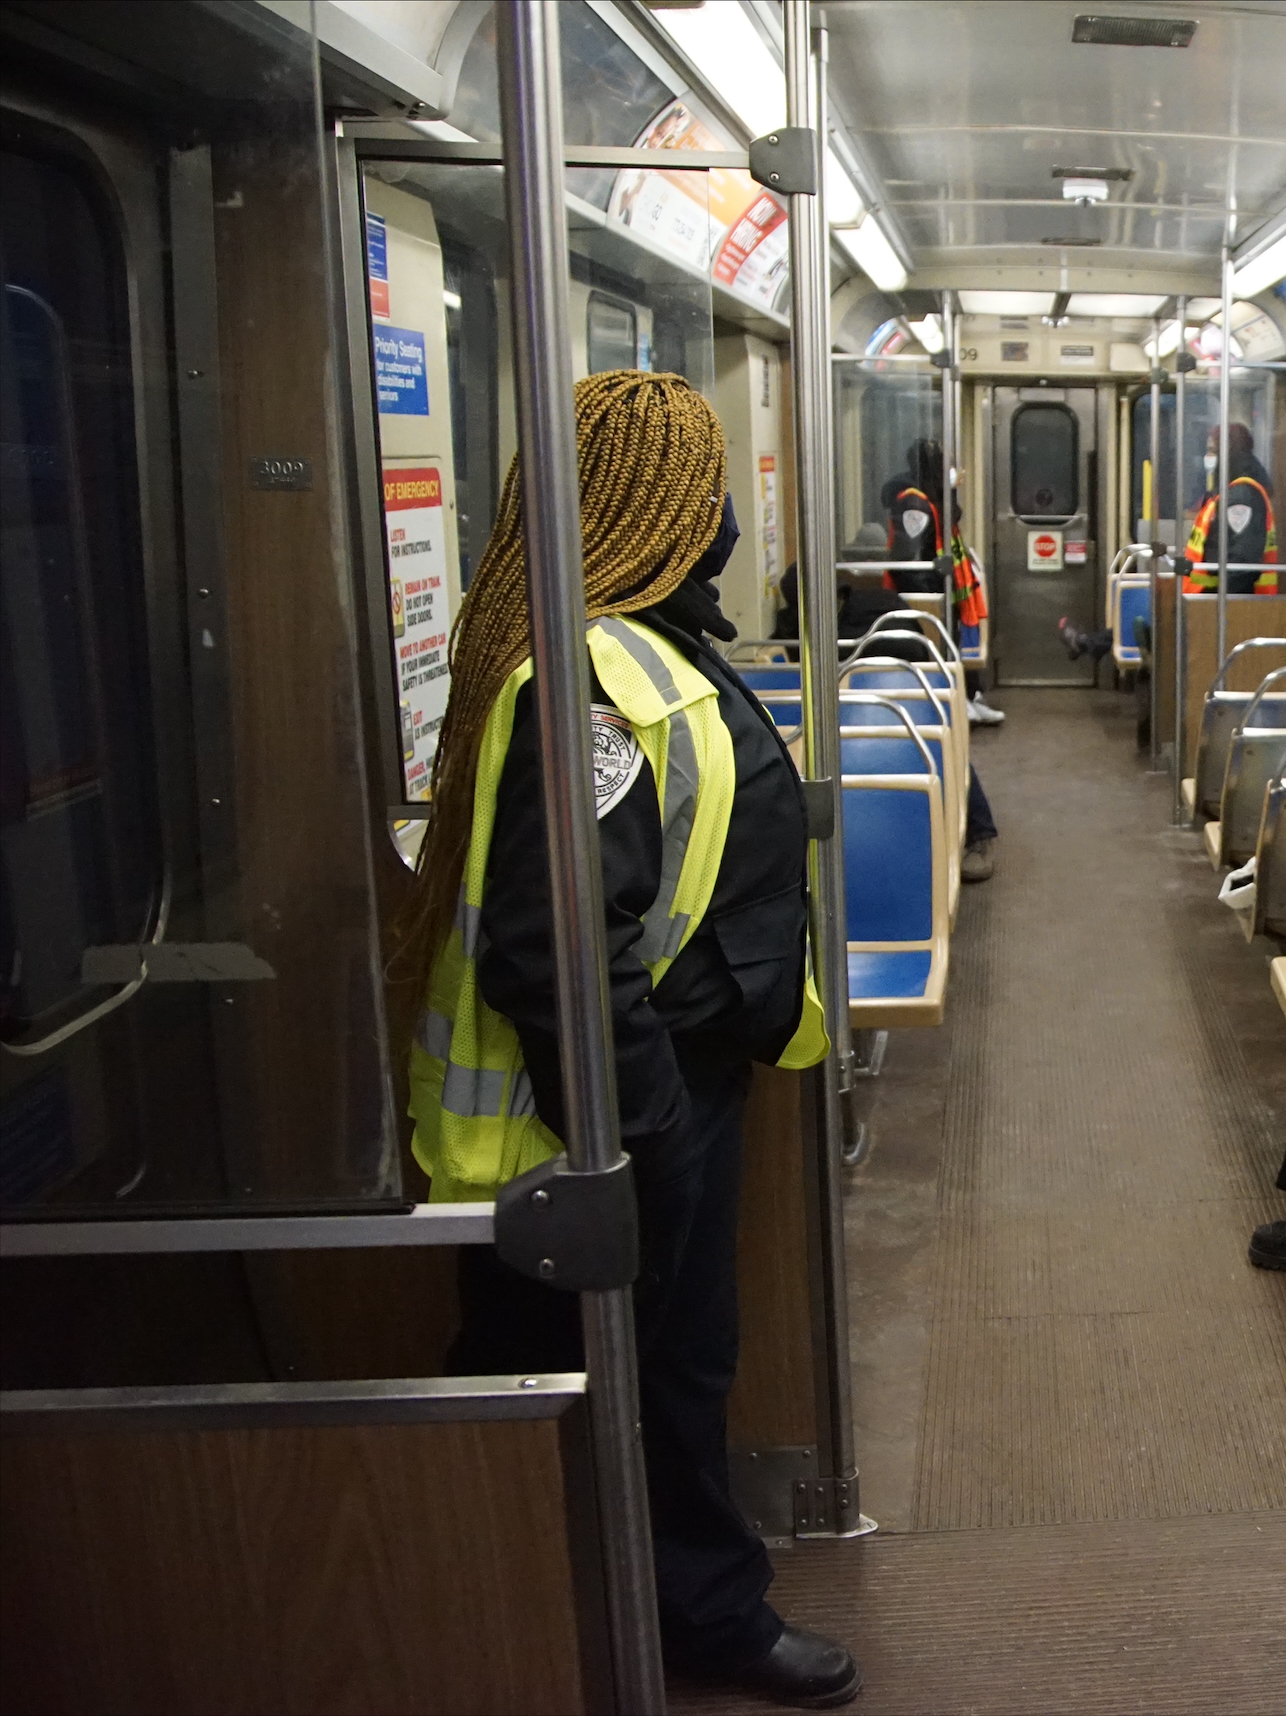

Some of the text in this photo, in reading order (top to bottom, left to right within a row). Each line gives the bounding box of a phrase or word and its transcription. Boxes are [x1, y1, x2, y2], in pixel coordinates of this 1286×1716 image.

[375, 336, 423, 363] Priority Seating
[385, 361, 411, 374] customers
[411, 364, 422, 376] with
[377, 374, 416, 389] disabilities and
[384, 480, 439, 501] OF EMERGENCY
[390, 528, 406, 543] LISTEN
[391, 544, 401, 558] FOR
[1034, 542, 1056, 551] STOP
[405, 580, 420, 595] REMAIN
[421, 578, 428, 592] ON
[406, 592, 434, 611] DO NOT OPEN
[407, 613, 417, 627] SIDE
[400, 632, 447, 659] MOVE TO ANOTHER CAR
[401, 650, 440, 676] IF YOUR IMMEDIATE
[402, 674, 418, 692] SAFETY
[608, 730, 625, 751] TRUST
[597, 773, 624, 795] RESPECT
